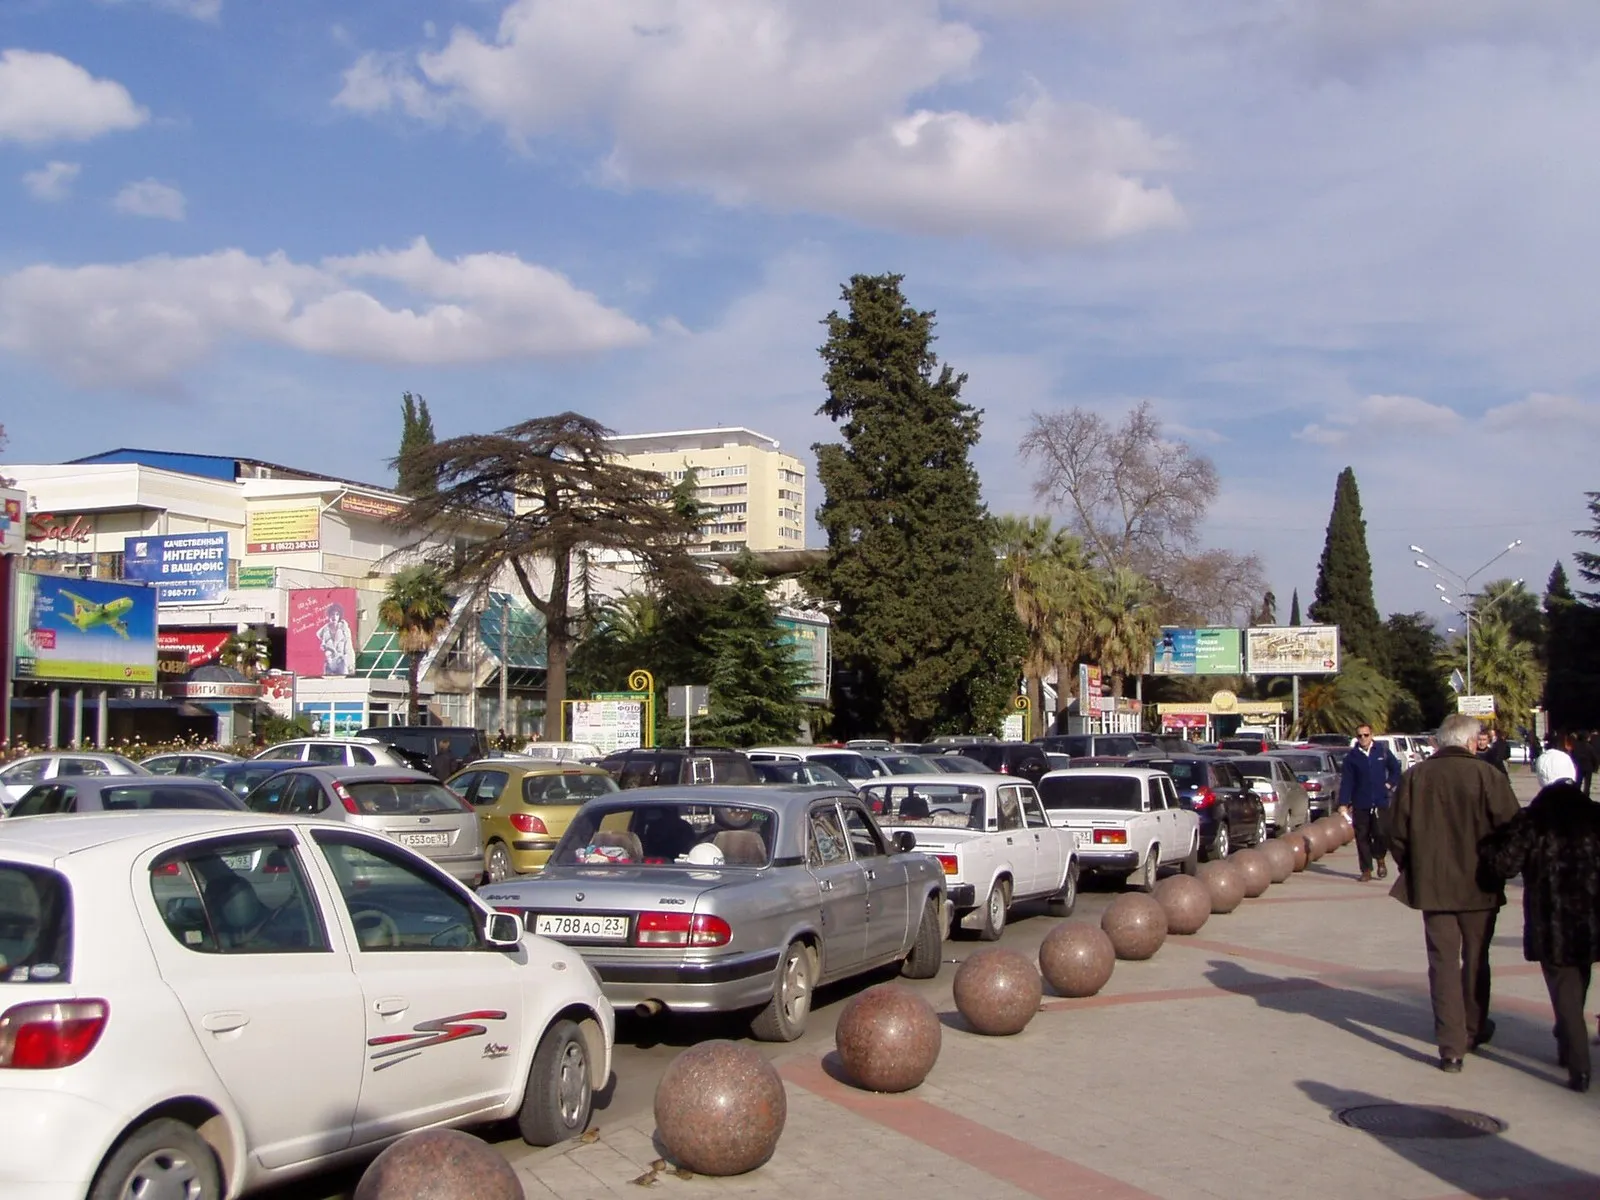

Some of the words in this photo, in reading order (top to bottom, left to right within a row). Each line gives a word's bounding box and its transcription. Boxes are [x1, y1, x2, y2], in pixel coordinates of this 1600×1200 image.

[163, 536, 224, 548] КАЧЕСТВЕННЫЙ
[162, 548, 224, 561] ИНТЕРНЕТ
[162, 564, 169, 573] В
[171, 562, 193, 573] ВАШ
[194, 561, 224, 572] ОФИС
[604, 918, 620, 931] 23
